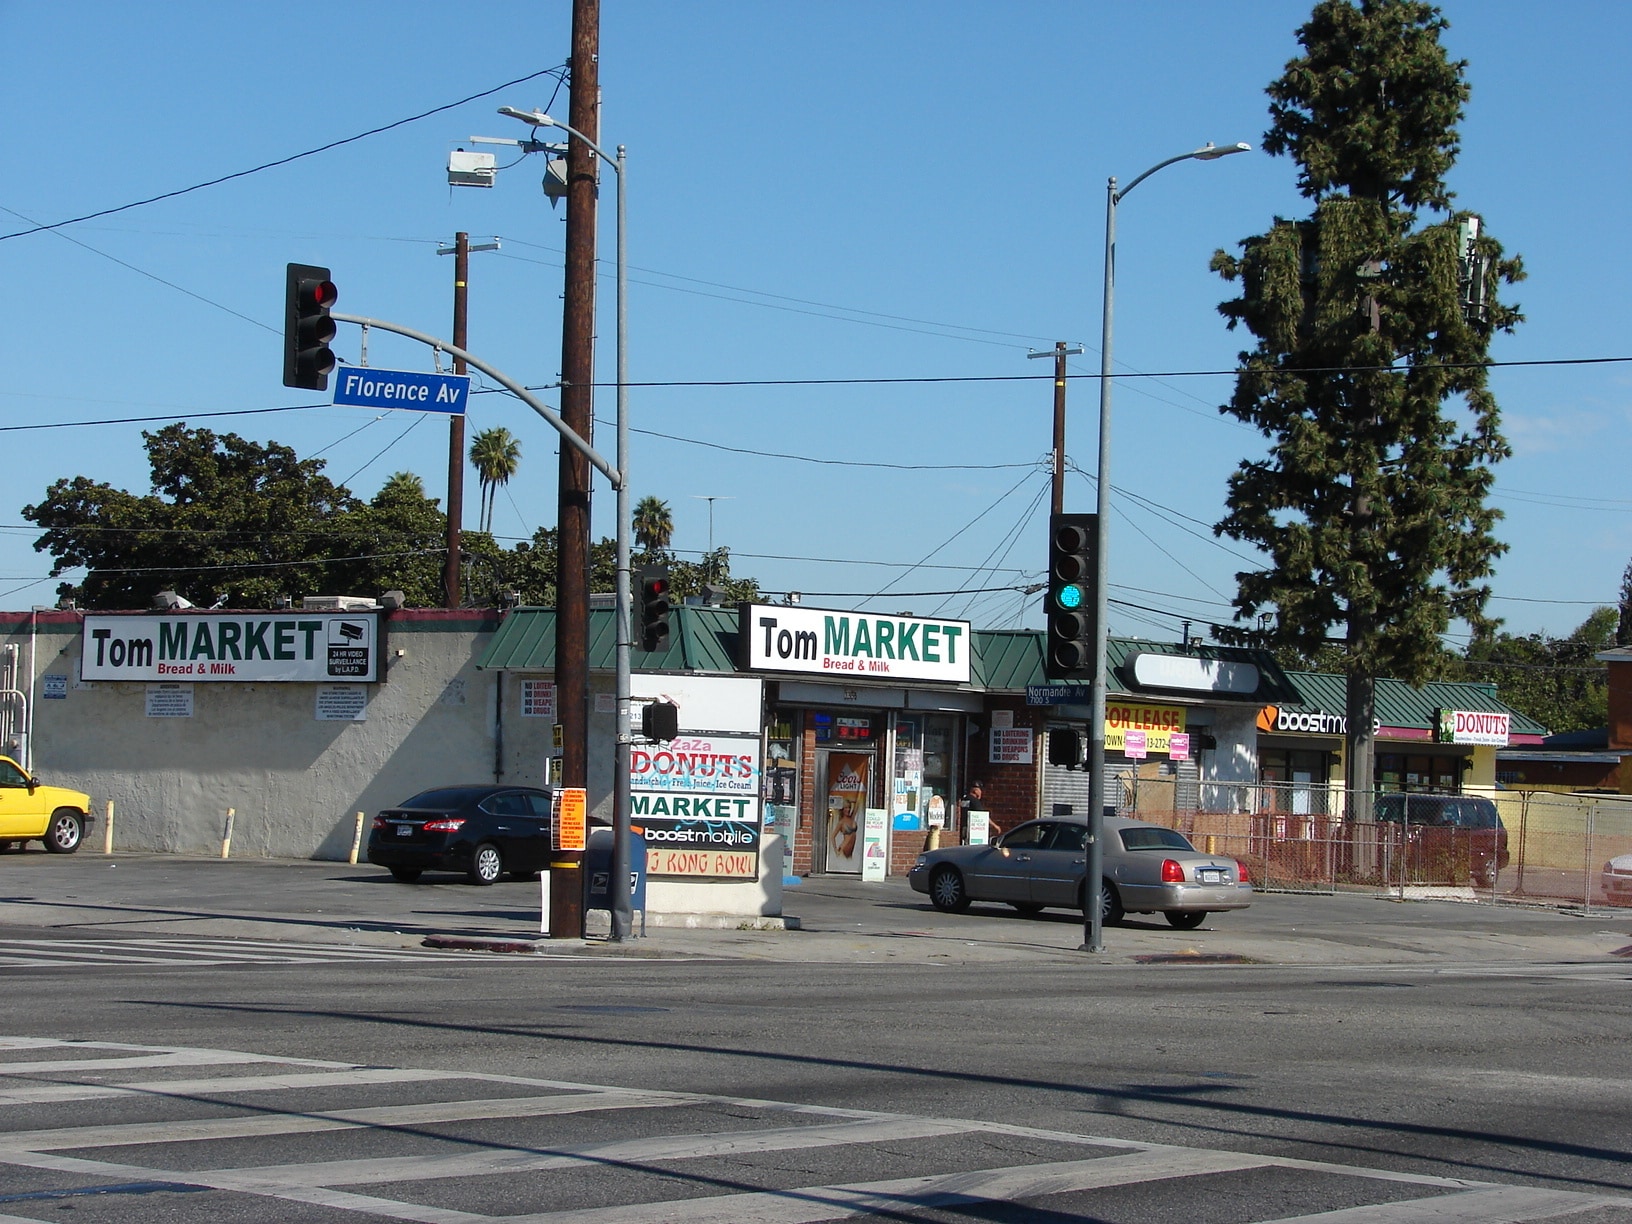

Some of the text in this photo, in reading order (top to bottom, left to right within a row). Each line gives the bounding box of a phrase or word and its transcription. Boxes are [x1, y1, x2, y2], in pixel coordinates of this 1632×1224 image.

[346, 375, 460, 404] Florence Av
[92, 620, 322, 667] Tom MARKET
[759, 615, 962, 664] Tom MARKET
[157, 663, 235, 675] Bread & Milk
[823, 657, 890, 673] Bread & Milk
[1028, 686, 1086, 697] Normandie Av
[1030, 696, 1050, 704] 7100 S
[1134, 708, 1181, 732] LEASE
[1456, 713, 1507, 735] DONUTS
[671, 739, 711, 751] ZaZa
[1002, 745, 1029, 753] WEAPONS
[630, 751, 751, 778] DONUTS
[693, 779, 711, 789] Juice
[716, 779, 727, 789] Ice
[729, 780, 751, 790] Cream
[630, 796, 751, 818] MARKET
[644, 827, 753, 846] boostmobile
[667, 852, 708, 873] KONG
